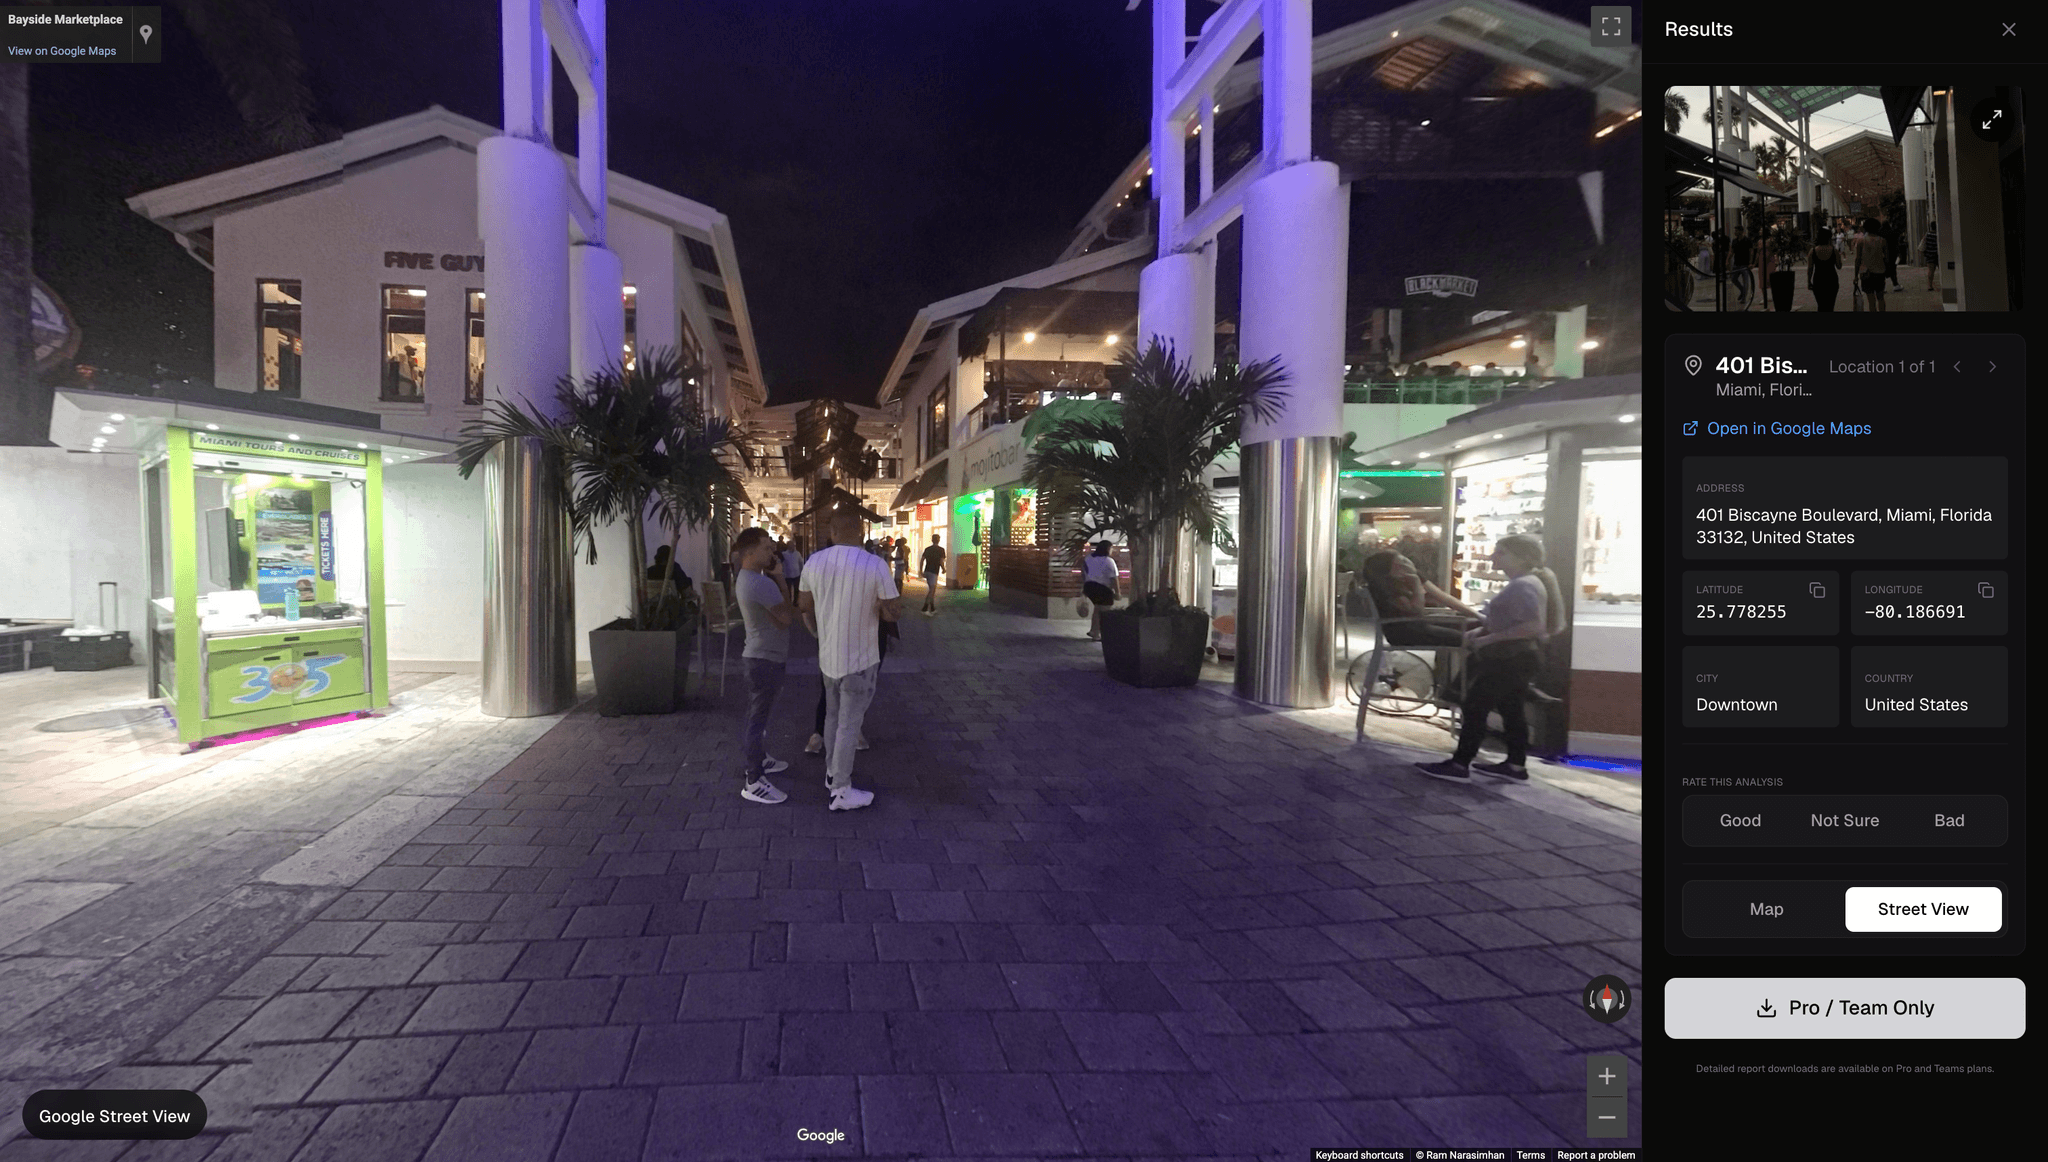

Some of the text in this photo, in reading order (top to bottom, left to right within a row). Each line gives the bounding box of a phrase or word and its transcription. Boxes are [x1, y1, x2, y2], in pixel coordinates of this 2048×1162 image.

[1665, 22, 1734, 36] Results
[384, 251, 434, 270] FIVE
[1715, 357, 1753, 374] 401
[1829, 360, 1935, 373] Location 1 of 1
[1716, 383, 1766, 398] Miami,
[1707, 422, 1872, 437] Open in Google Maps
[200, 436, 360, 461] MIAMI TOURS AND CRUISES
[1695, 484, 1745, 492] ADDRESS
[1695, 508, 1993, 524] 401 Biscayne Boulevard, Miami, Florida
[1696, 531, 1855, 546] 33132, United States
[319, 517, 330, 575] TICKETS HERE
[1696, 586, 1744, 594] LATITUDE
[1864, 586, 1923, 594] LONGITUDE
[1696, 605, 1787, 618] 25.778255
[1695, 674, 1719, 682] CITY
[1864, 674, 1914, 682] COUNTRY
[1696, 698, 1778, 711] Downtown
[1865, 698, 1969, 711] United States
[1682, 778, 1784, 786] RATE THIS ANALYSIS
[1719, 814, 1761, 827] Good
[1811, 814, 1880, 826] Not Sure
[1934, 814, 1965, 826] Bad
[1750, 903, 1784, 918] Map
[1878, 903, 1970, 915] Street View
[1789, 1000, 1820, 1015] Pro
[1838, 1000, 1888, 1015] Team
[1893, 1000, 1935, 1018] Only
[1696, 1064, 1735, 1072] Detailed
[1737, 1065, 1766, 1074] report
[1896, 1064, 1913, 1072] Pro
[1933, 1064, 1965, 1072] Teams
[1966, 1065, 1995, 1074] plans.
